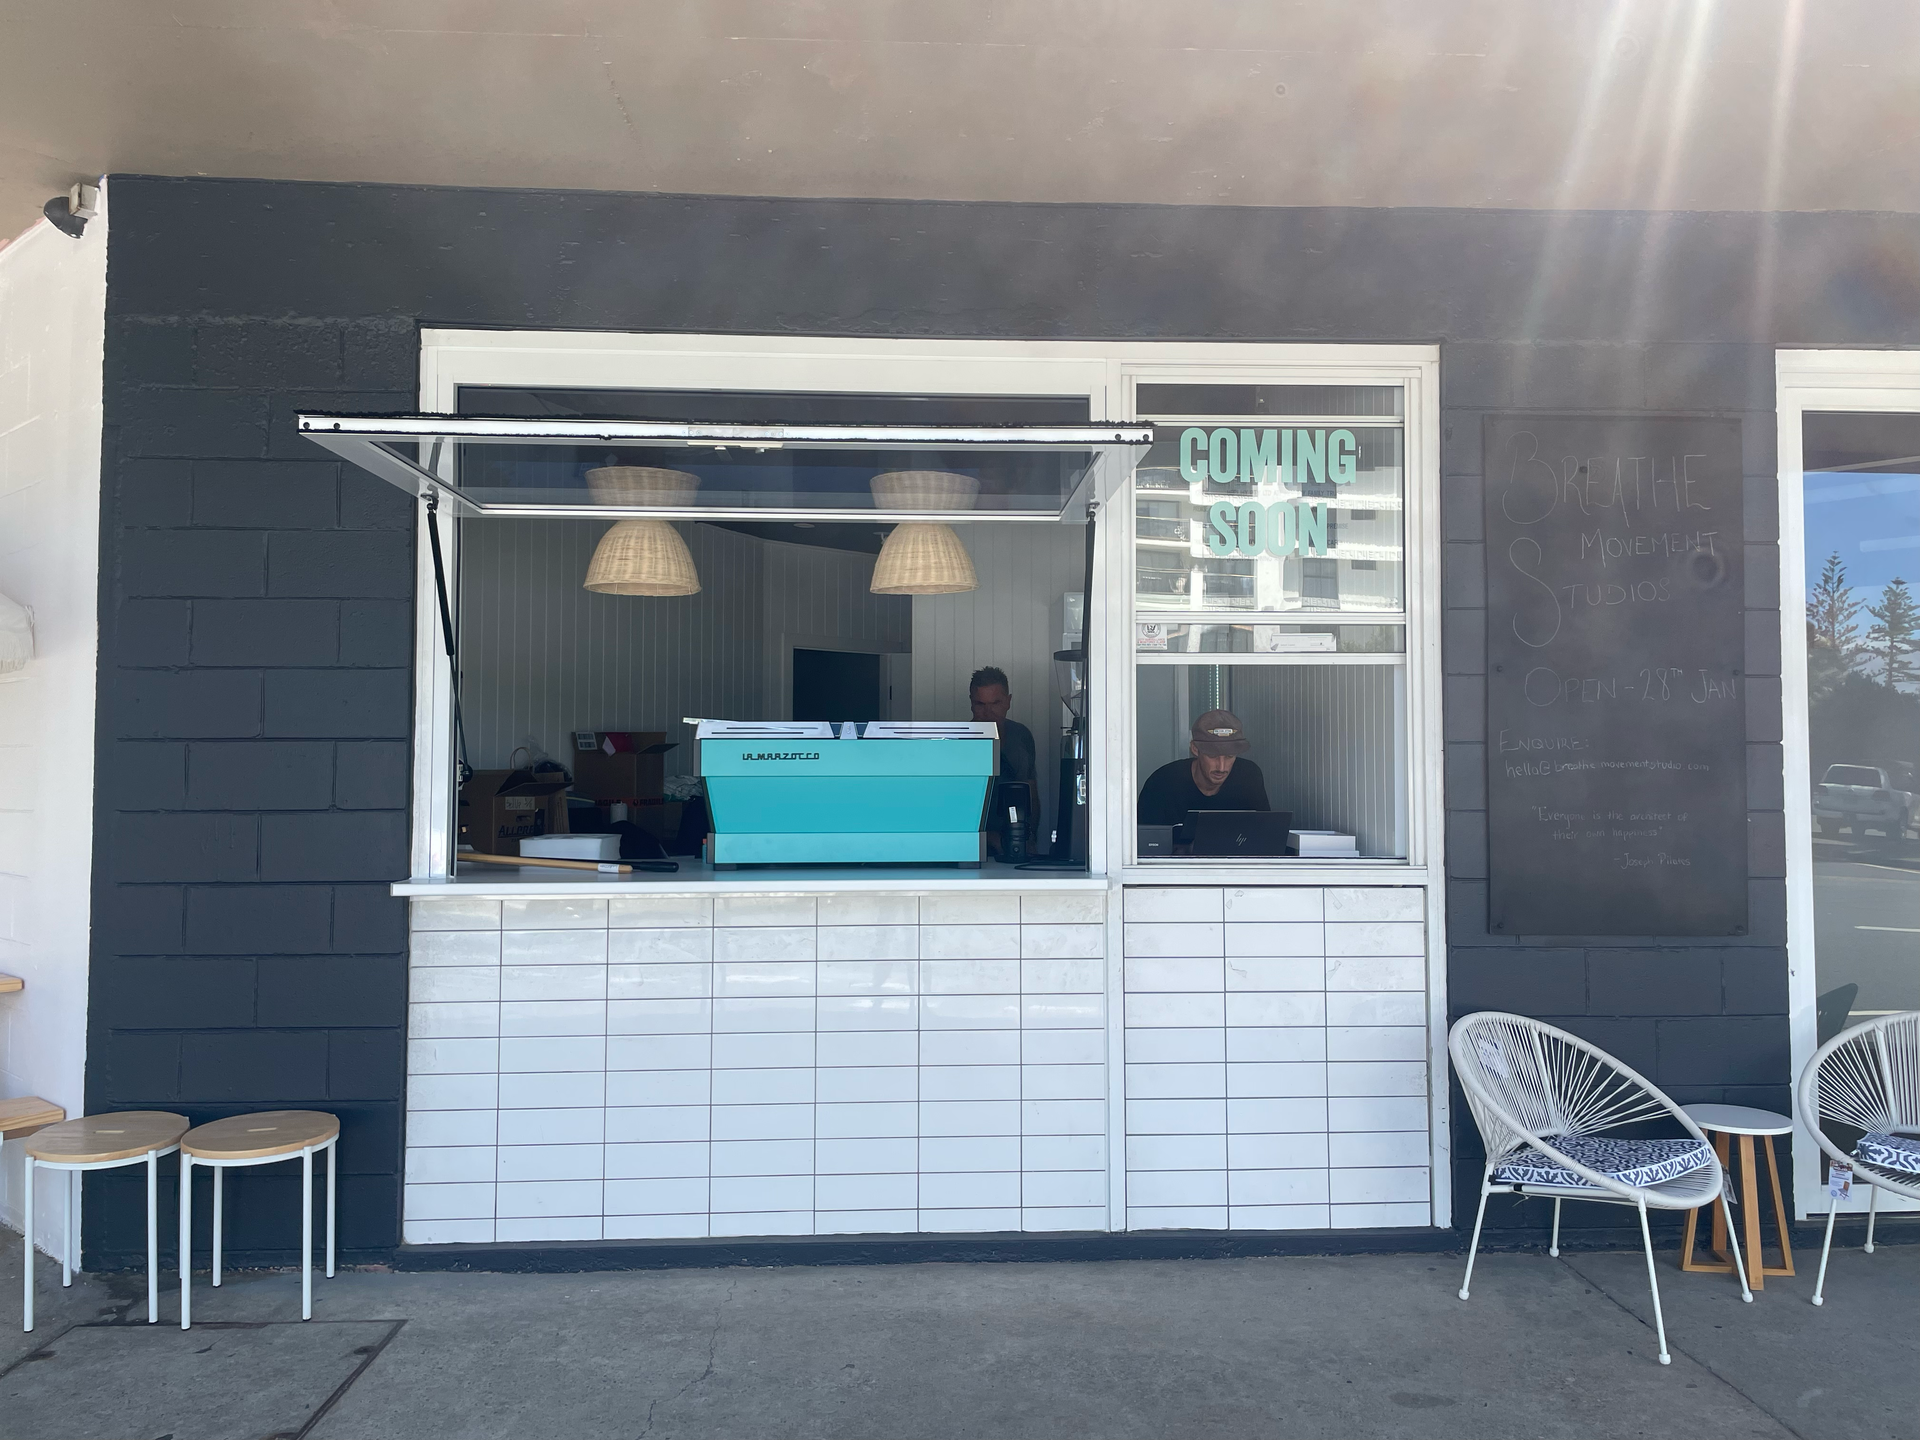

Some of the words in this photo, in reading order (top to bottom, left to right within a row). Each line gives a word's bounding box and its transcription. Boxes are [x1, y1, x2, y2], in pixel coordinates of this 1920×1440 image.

[1179, 427, 1357, 484] COMING
[1502, 430, 1711, 528] BREATHE
[1209, 501, 1328, 556] SOON
[1580, 528, 1718, 568] MOVEMENT
[1509, 537, 1670, 648] STUDIOS
[1524, 666, 1616, 707] OPEN
[1691, 668, 1737, 703] JAN
[1552, 829, 1579, 841] their
[1585, 829, 1606, 838] own
[1592, 809, 1602, 821] is
[1607, 809, 1625, 822] the
[1657, 852, 1692, 867] Pilates
